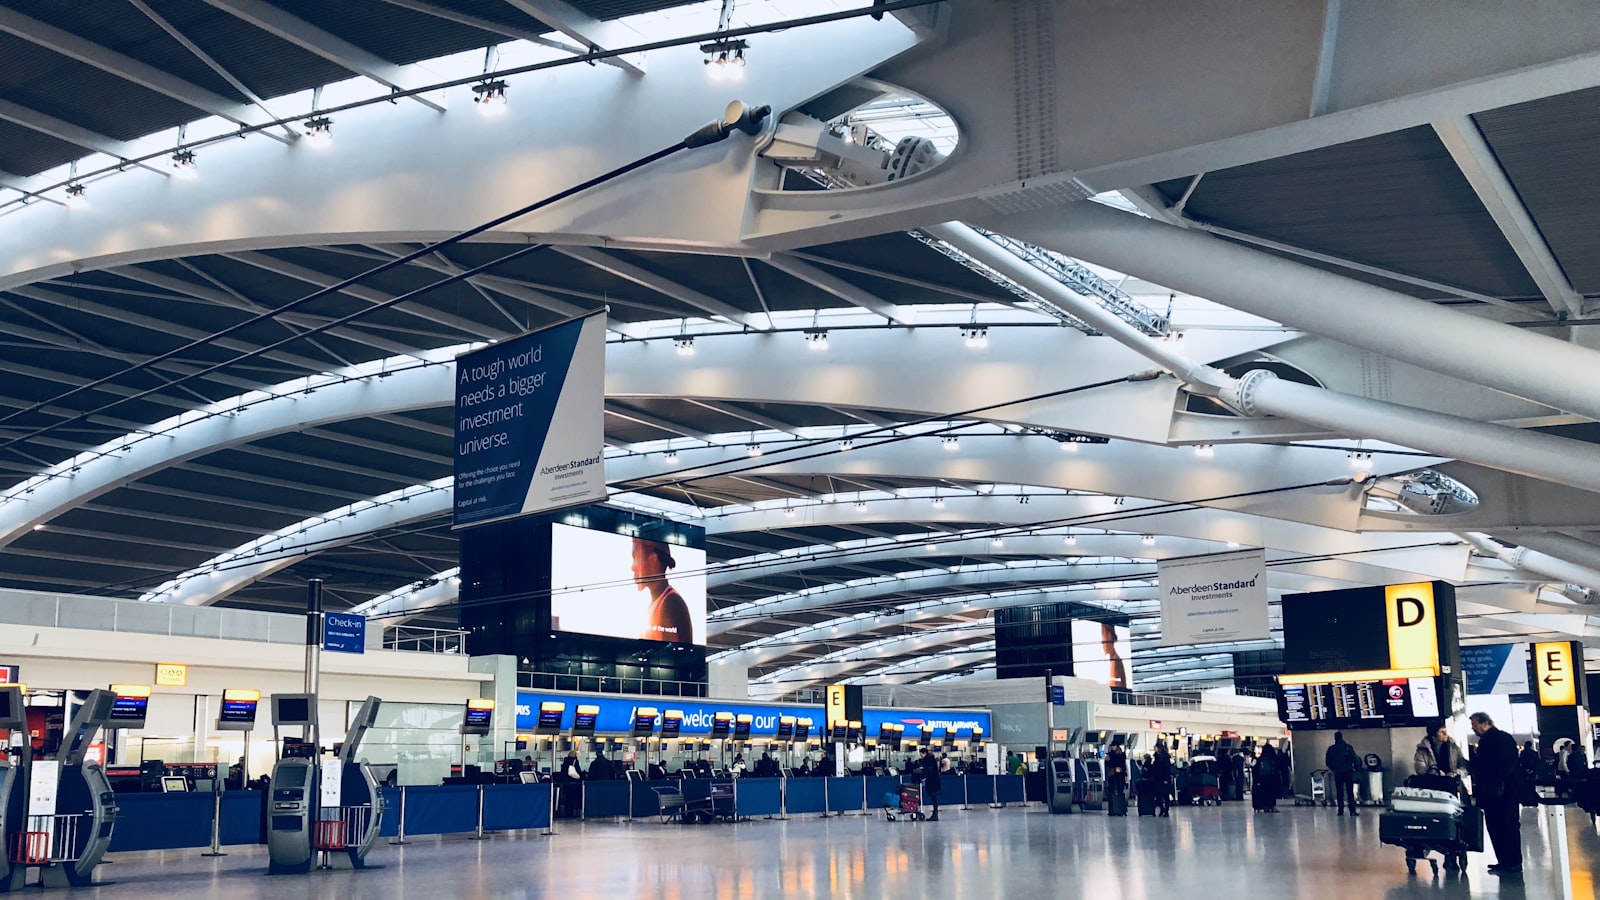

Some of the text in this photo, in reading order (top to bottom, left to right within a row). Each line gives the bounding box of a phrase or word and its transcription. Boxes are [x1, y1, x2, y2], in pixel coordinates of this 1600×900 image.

[460, 343, 542, 384] A tough world
[460, 371, 547, 408] needs a bigger
[460, 402, 523, 432] investment
[459, 431, 510, 456] universe.
[458, 471, 477, 480] Offering
[484, 465, 499, 474] choice
[499, 464, 508, 472] you
[508, 460, 521, 469] need
[540, 455, 600, 476] AberdeenStandard
[554, 469, 584, 480] Investments
[472, 476, 496, 485] challenges
[496, 474, 505, 483] you
[457, 498, 473, 508] Capital
[1170, 578, 1256, 595] AberdeenStandard
[1191, 591, 1233, 601] Investments
[1396, 597, 1425, 627] D
[328, 616, 362, 628] Check-in
[1547, 651, 1562, 672] E
[832, 691, 840, 705] E
[755, 715, 777, 729] our
